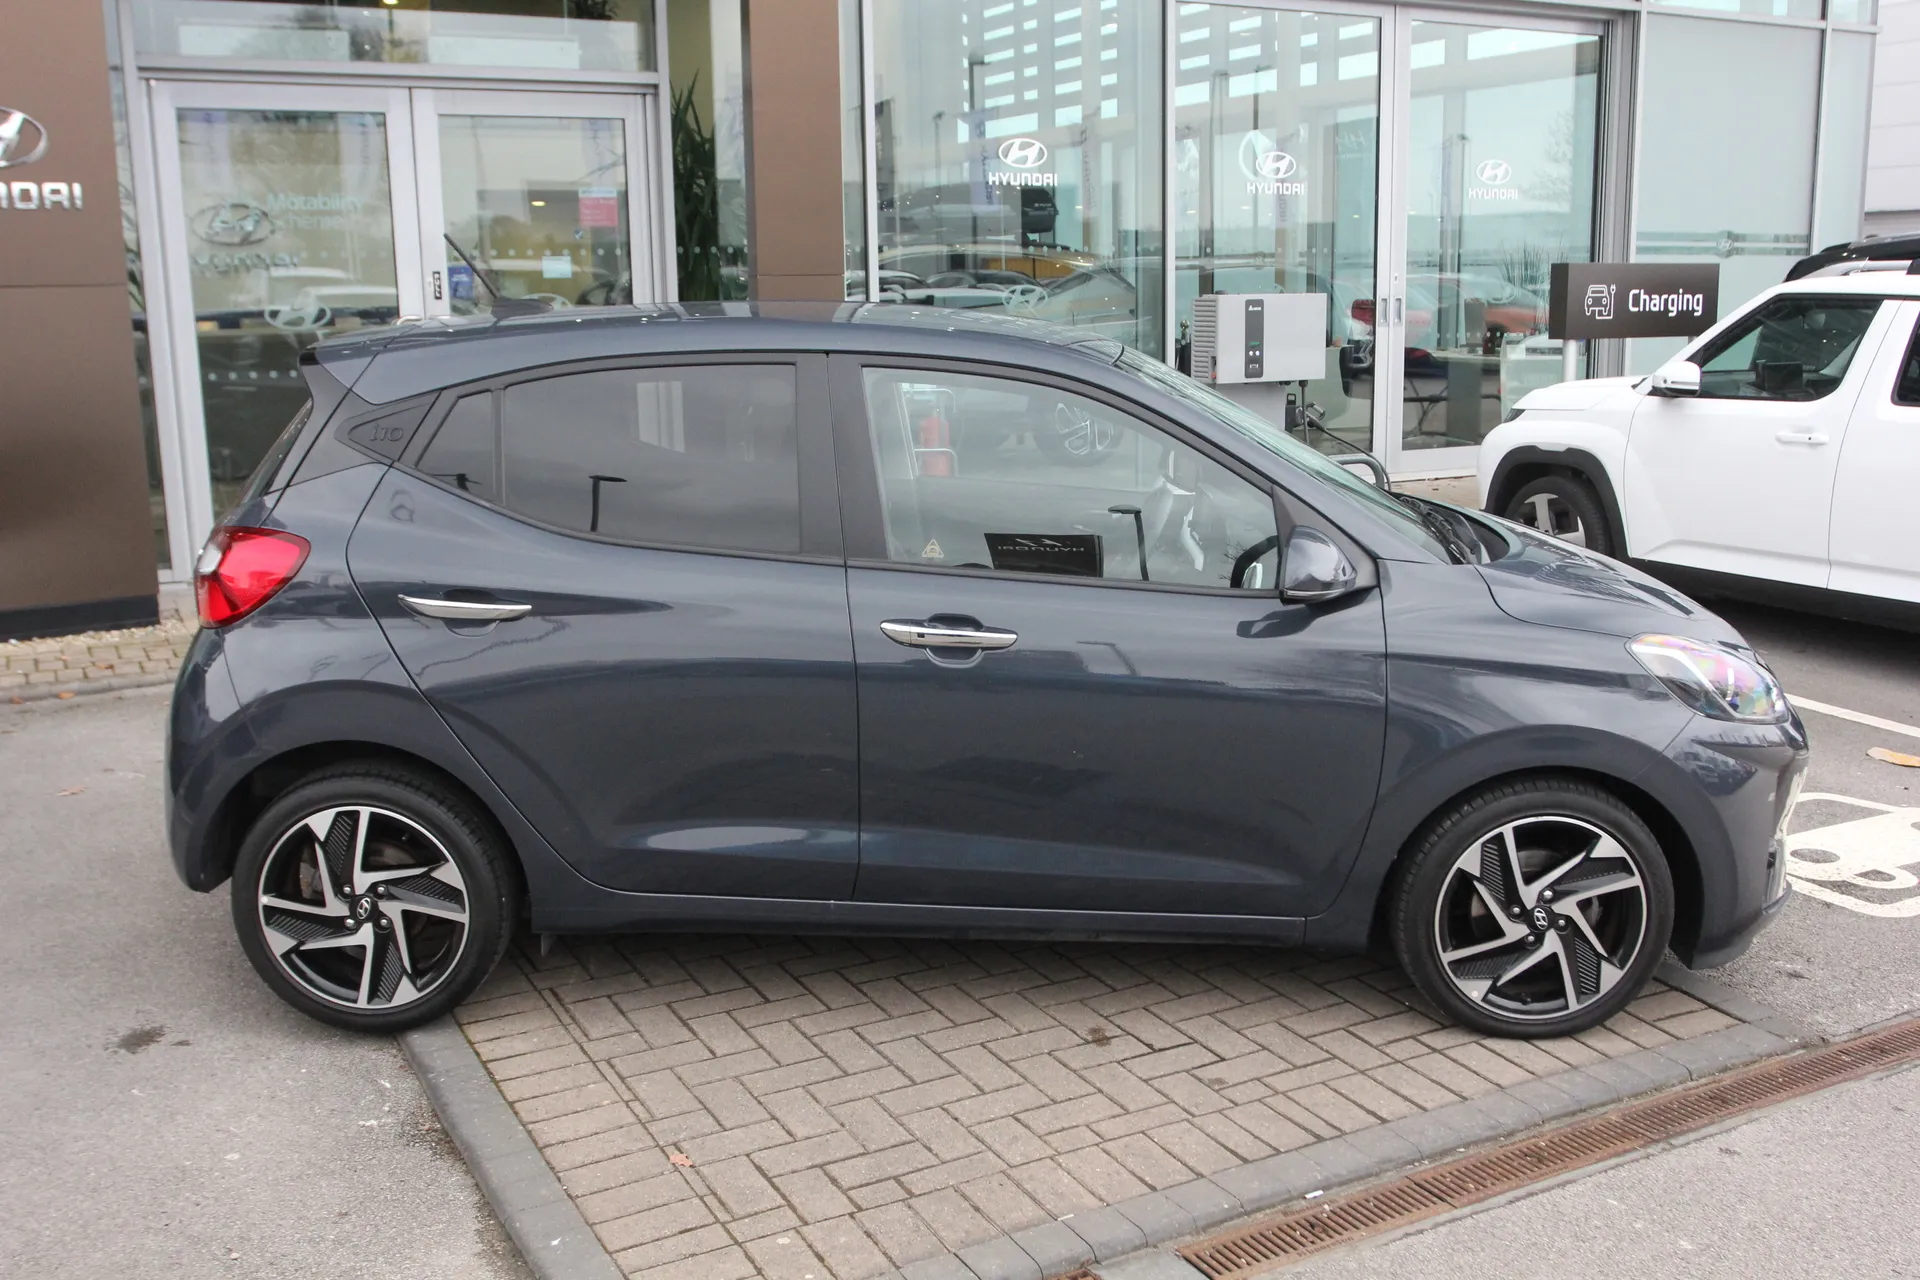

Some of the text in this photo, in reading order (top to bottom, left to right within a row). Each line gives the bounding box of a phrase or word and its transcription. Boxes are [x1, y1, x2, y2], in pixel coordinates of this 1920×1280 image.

[988, 171, 1058, 187] HYUNDAI
[1245, 181, 1305, 195] HYUNDAI
[1467, 187, 1519, 200] HYUNDAI
[1628, 288, 1704, 317] Charging
[369, 422, 404, 442] i10
